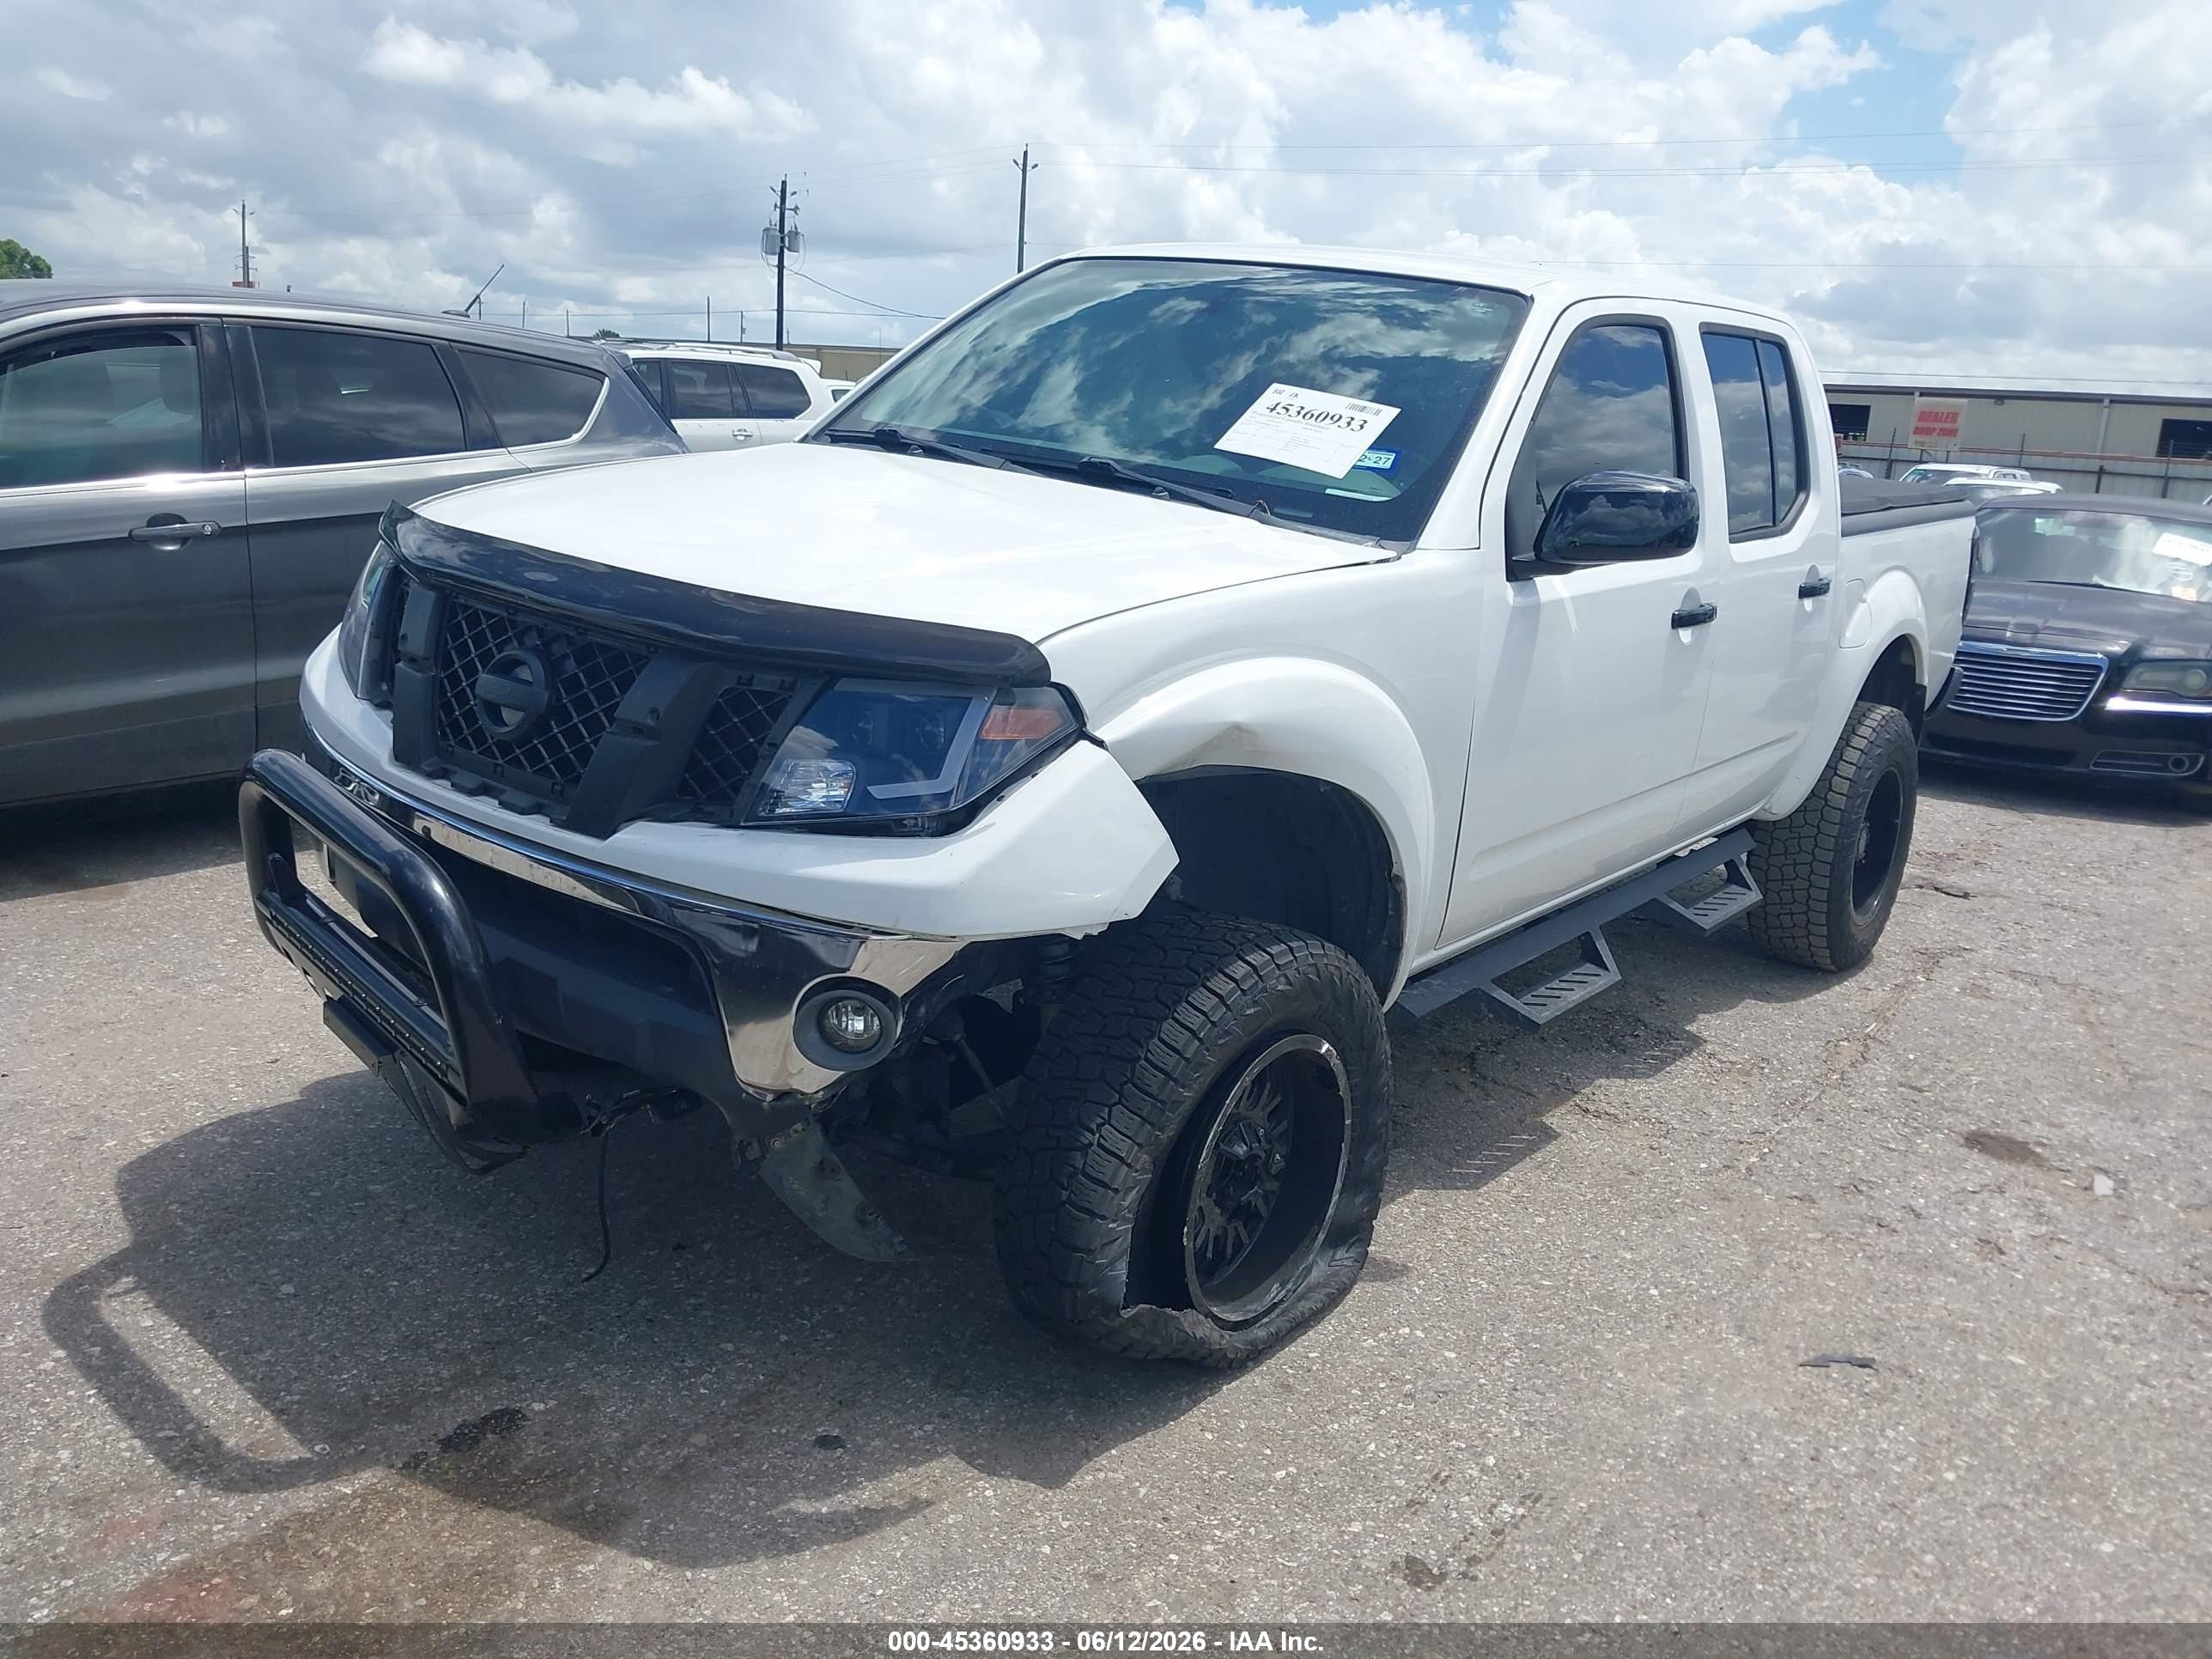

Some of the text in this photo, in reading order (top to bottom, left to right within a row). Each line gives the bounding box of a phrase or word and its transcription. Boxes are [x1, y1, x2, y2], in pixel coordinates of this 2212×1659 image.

[1266, 401, 1369, 432] 45360933
[1917, 411, 1959, 423] DEALER
[1913, 426, 1959, 437] DROP ZONE
